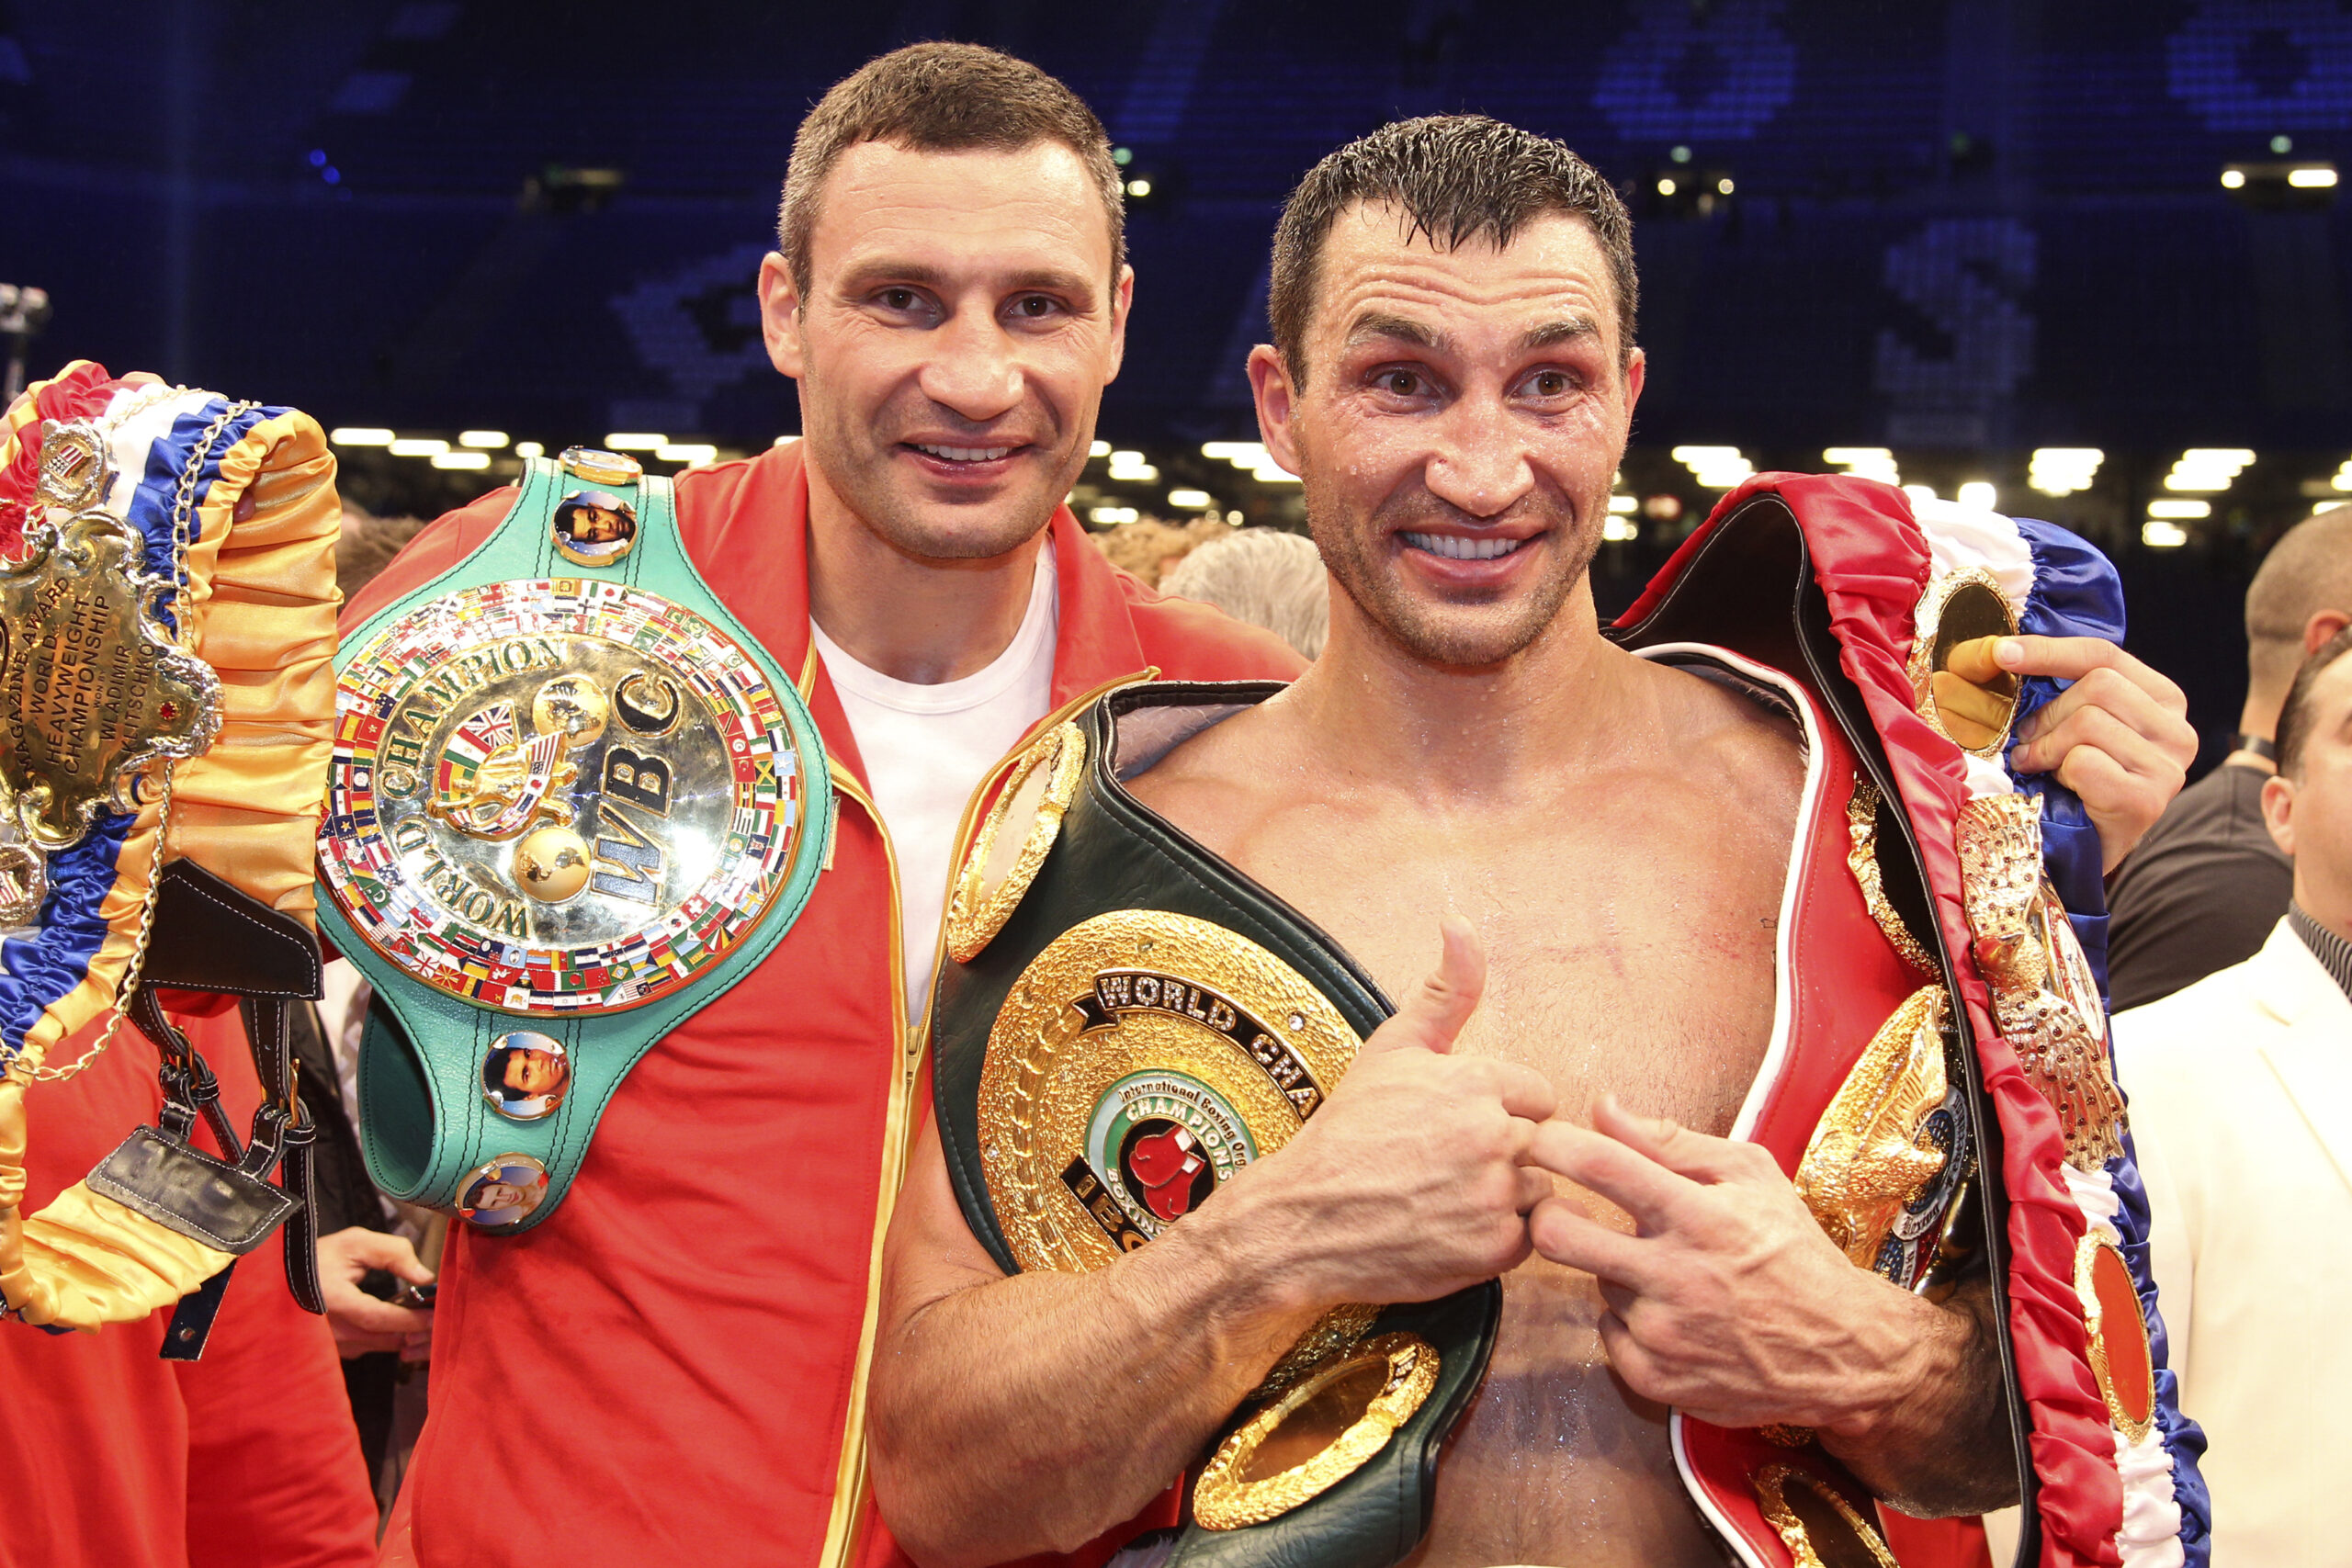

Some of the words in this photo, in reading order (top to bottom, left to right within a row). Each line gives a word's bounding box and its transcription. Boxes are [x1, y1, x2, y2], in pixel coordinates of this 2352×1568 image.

[8, 650, 34, 775] MAGAZINE
[22, 577, 70, 648] AWARD
[45, 595, 90, 766] HEAVYWEIGHT
[63, 595, 110, 776] CHAMPIONSHIP
[93, 682, 105, 710] WON
[100, 645, 132, 741] WLADIMIR
[121, 643, 155, 754] KLITSCHKO
[380, 637, 566, 800] CHAMPION
[590, 671, 684, 908] WBC
[395, 818, 531, 940] WORLD
[1099, 976, 1237, 1032] WORLD
[1118, 1078, 1201, 1102] International
[1200, 1098, 1236, 1141] Boxing
[1125, 1097, 1233, 1182] CHAMPIONS
